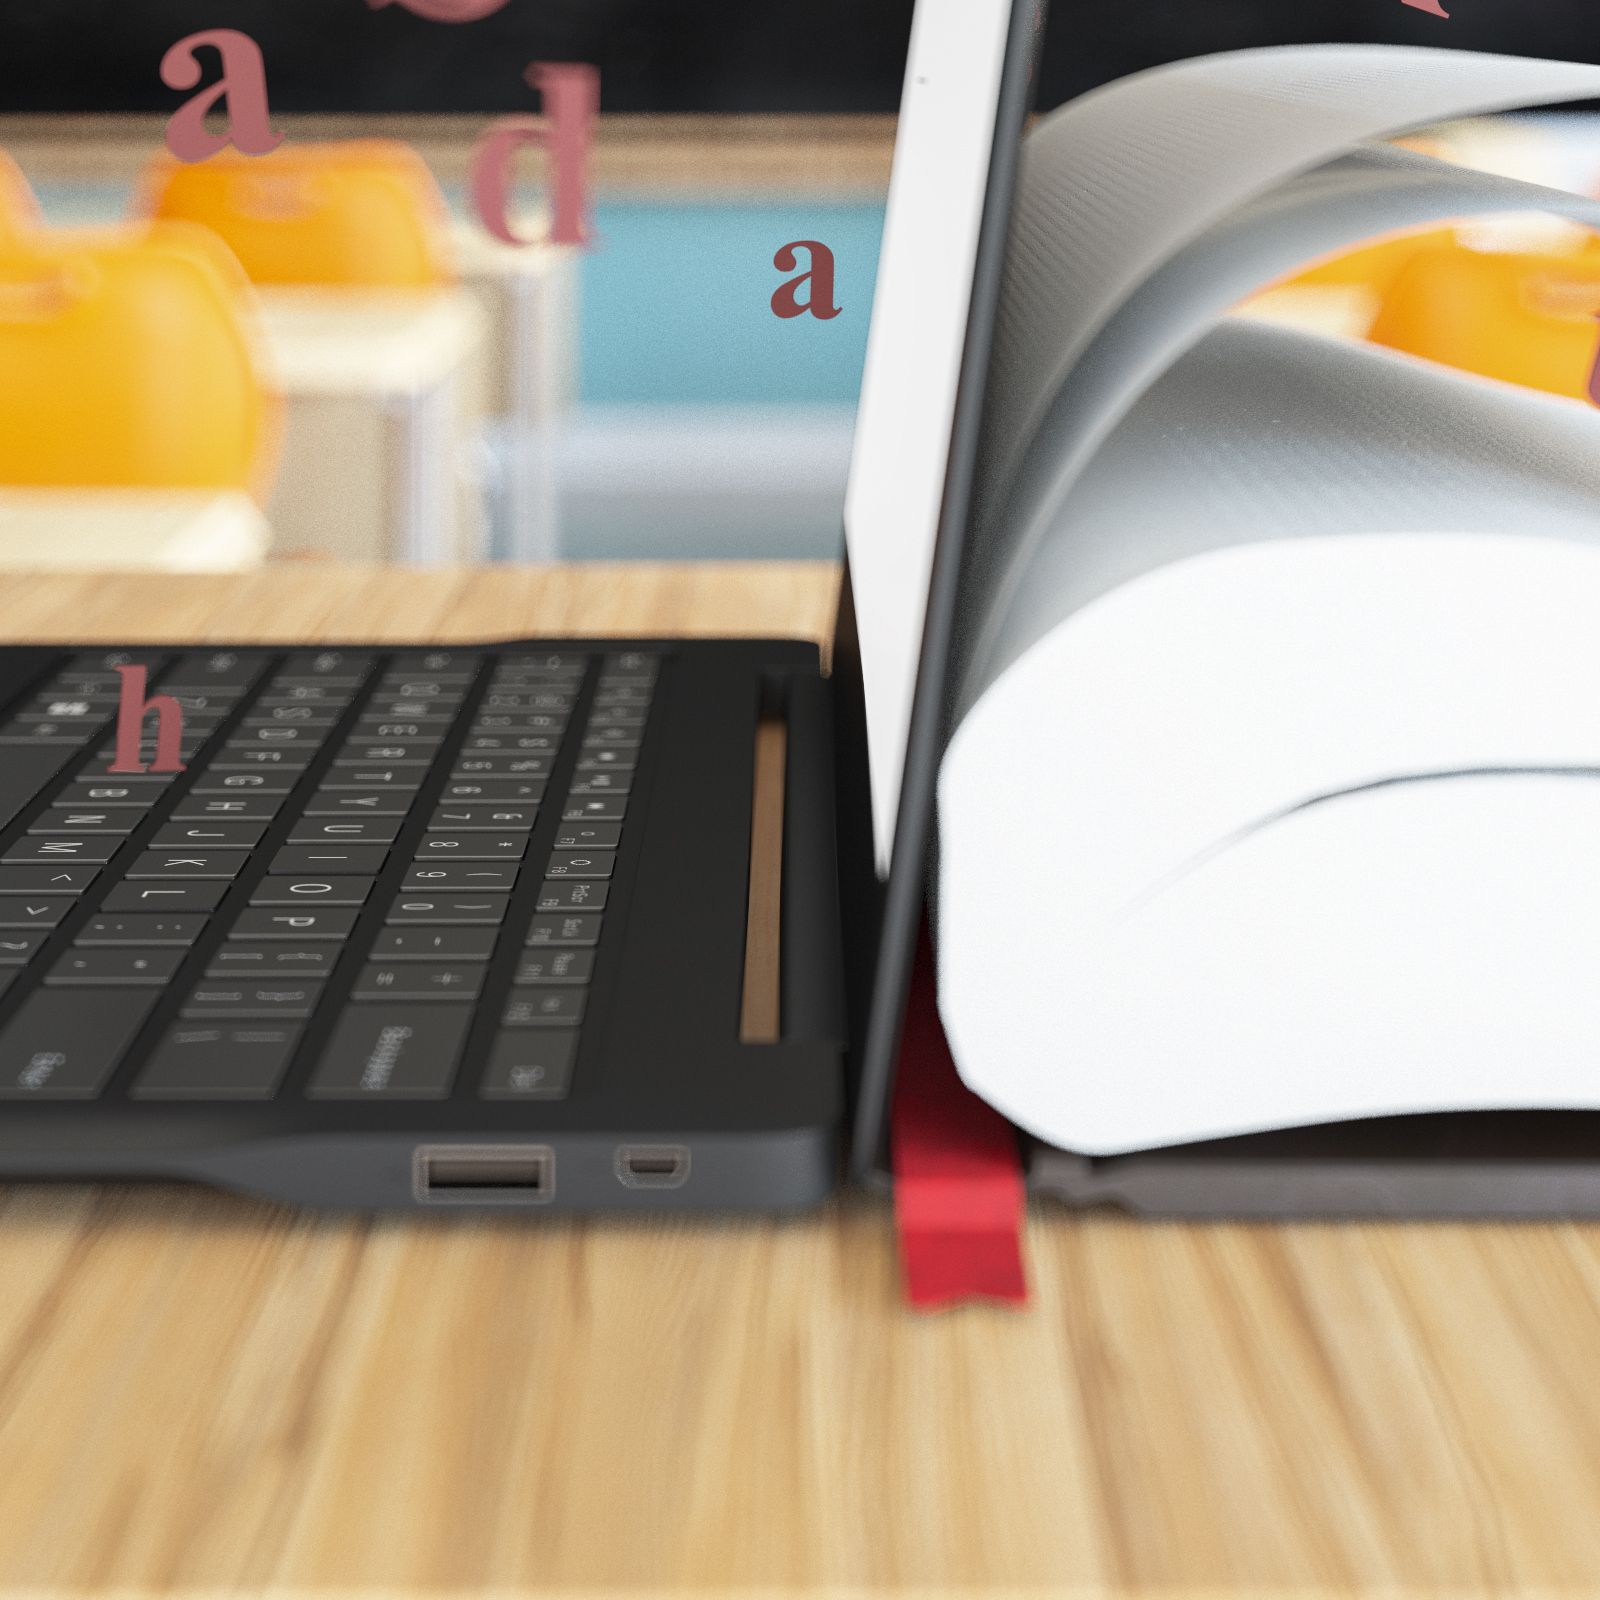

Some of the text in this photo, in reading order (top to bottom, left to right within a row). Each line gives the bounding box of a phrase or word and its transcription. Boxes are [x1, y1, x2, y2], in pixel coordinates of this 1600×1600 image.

[158, 28, 287, 162] a
[469, 61, 601, 247] d
[771, 241, 840, 320] a
[106, 664, 187, 773] h
[222, 775, 265, 786] G
[354, 771, 394, 782] T
[87, 788, 130, 798] B
[205, 801, 247, 811] H
[338, 796, 380, 807] Y
[62, 814, 108, 824] N
[185, 829, 226, 837] J
[322, 824, 365, 833] U
[36, 842, 85, 853] M
[162, 859, 209, 867] K
[140, 890, 187, 898] L
[272, 916, 317, 927] P
